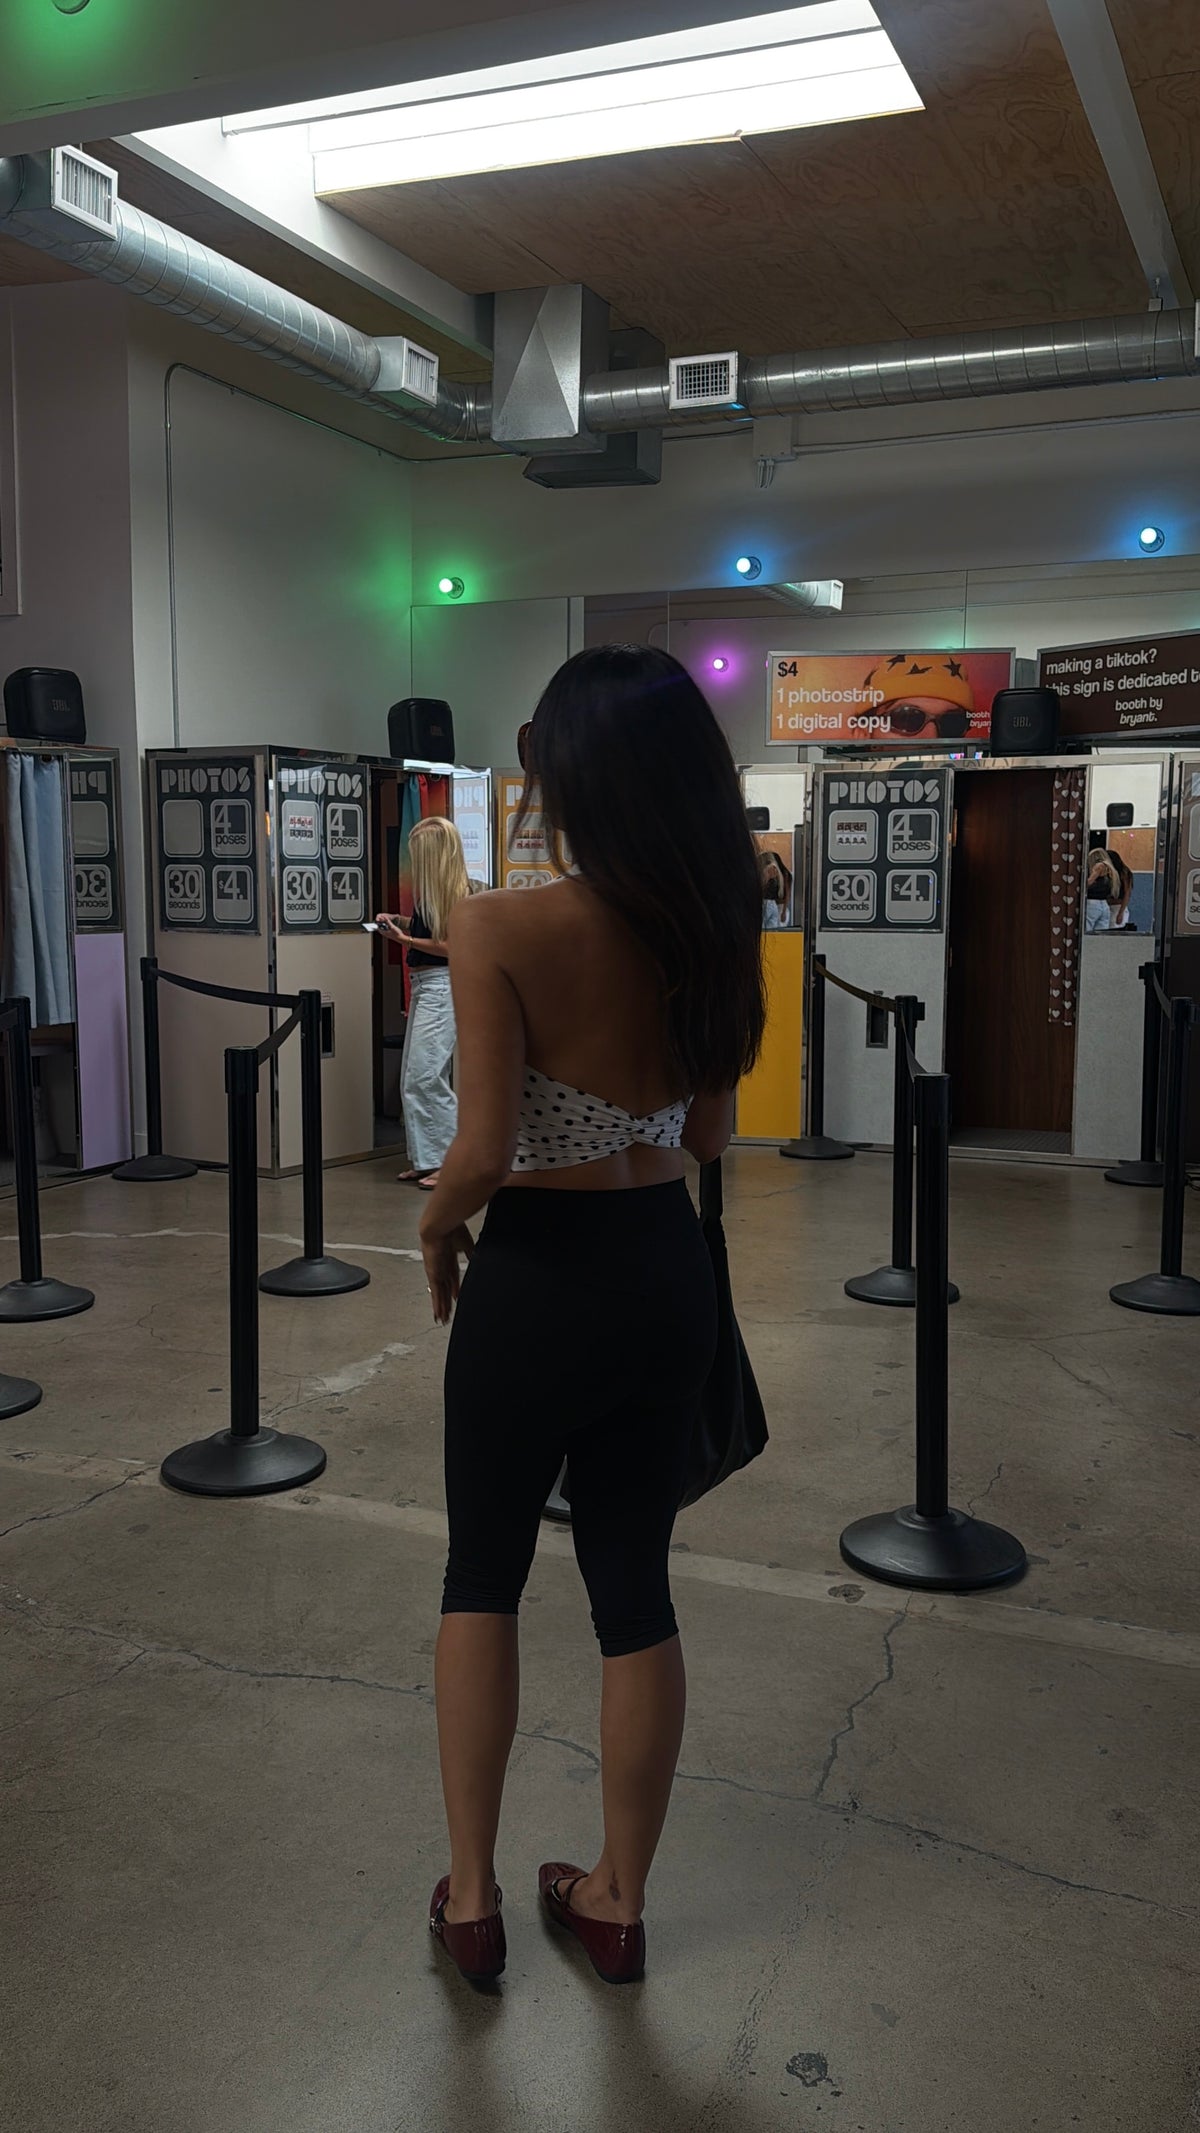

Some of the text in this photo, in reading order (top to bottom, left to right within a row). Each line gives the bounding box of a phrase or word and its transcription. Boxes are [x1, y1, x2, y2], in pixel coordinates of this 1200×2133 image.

[777, 660, 798, 678] $4
[1046, 648, 1158, 676] making a tiktok?
[1073, 679, 1100, 698] sign
[1103, 677, 1115, 692] is
[1117, 668, 1188, 691] dedicated
[776, 686, 885, 708] 1 photostrip
[1115, 697, 1164, 712] booth by
[776, 713, 892, 734] 1 digital copy
[966, 711, 991, 719] booth
[1119, 712, 1158, 727] bryant.
[160, 766, 251, 794] PHOTOS
[280, 767, 363, 799] PHOTOS
[829, 778, 940, 805] PHOTOS
[215, 804, 232, 835] 4
[331, 809, 346, 837] 4
[892, 814, 913, 841] 4
[215, 833, 247, 848] poses
[331, 837, 359, 849] poses
[892, 840, 931, 854] poses
[168, 870, 200, 899] 30
[287, 871, 317, 900] 30
[832, 875, 870, 901] 30
[168, 900, 201, 910] seconds
[286, 902, 317, 911] seconds
[830, 901, 870, 911] seconds
